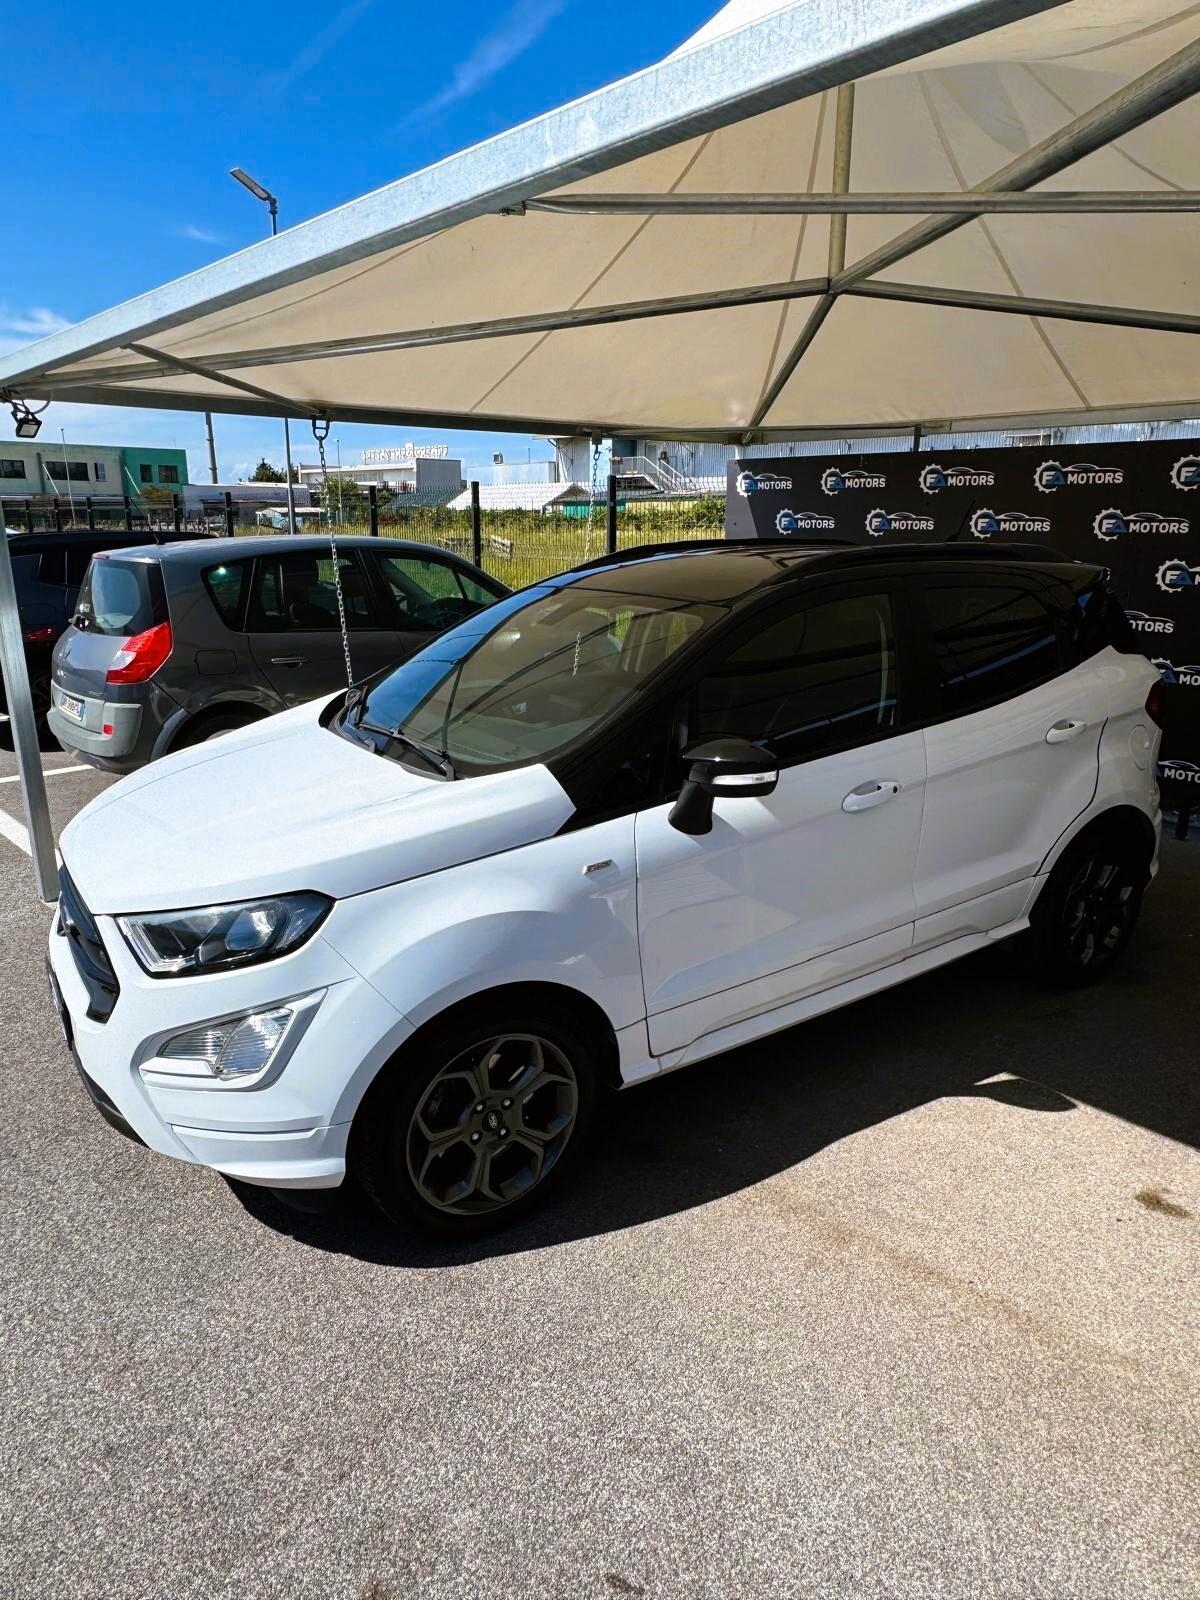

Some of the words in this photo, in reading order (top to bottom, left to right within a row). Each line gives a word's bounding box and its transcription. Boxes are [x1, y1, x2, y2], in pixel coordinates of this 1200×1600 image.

[826, 478, 845, 489] FA
[845, 477, 886, 488] MOTORS
[925, 472, 946, 487] FA
[947, 474, 995, 487] MOTORS
[1041, 471, 1066, 485] FA
[1067, 472, 1124, 485] MOTORS
[758, 481, 793, 490] MOTORS
[780, 518, 797, 529] FA
[798, 519, 835, 529] MOTORS
[871, 518, 890, 529] FA
[890, 519, 935, 530] MOTORS
[977, 518, 1000, 531] FA
[1000, 520, 1051, 532] MOTORS
[1101, 519, 1129, 533] FA
[1129, 522, 1190, 534] MOTORS
